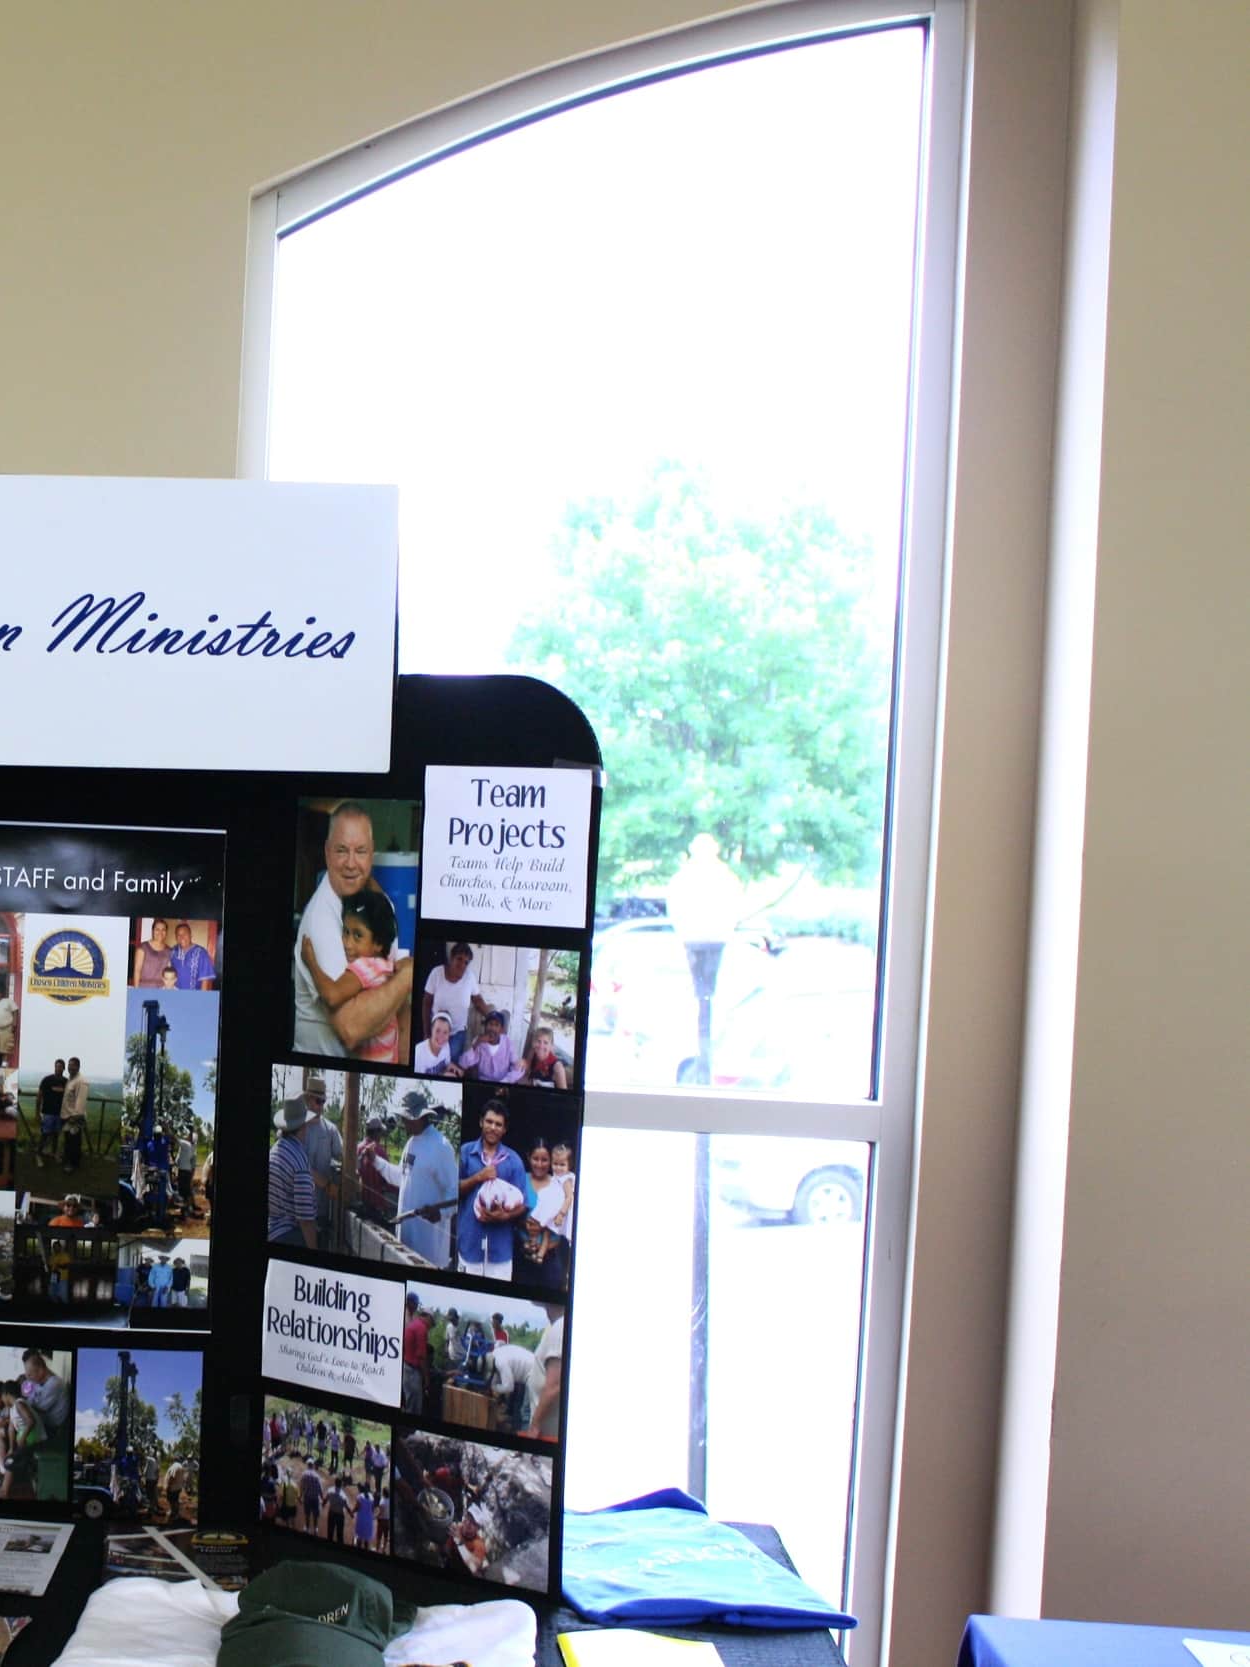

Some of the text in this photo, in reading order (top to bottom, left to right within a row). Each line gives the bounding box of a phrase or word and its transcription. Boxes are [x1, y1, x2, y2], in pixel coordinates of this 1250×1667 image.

[47, 592, 355, 659] Ministries
[471, 779, 546, 808] Team
[449, 817, 566, 855] Projects
[450, 855, 566, 874] Teams Help Build
[63, 868, 105, 891] and
[113, 870, 184, 901] Family
[439, 873, 572, 893] Churches, Classroom,
[459, 893, 552, 912] Wells, & More
[294, 1274, 371, 1323] Building
[267, 1306, 400, 1363] Relationships
